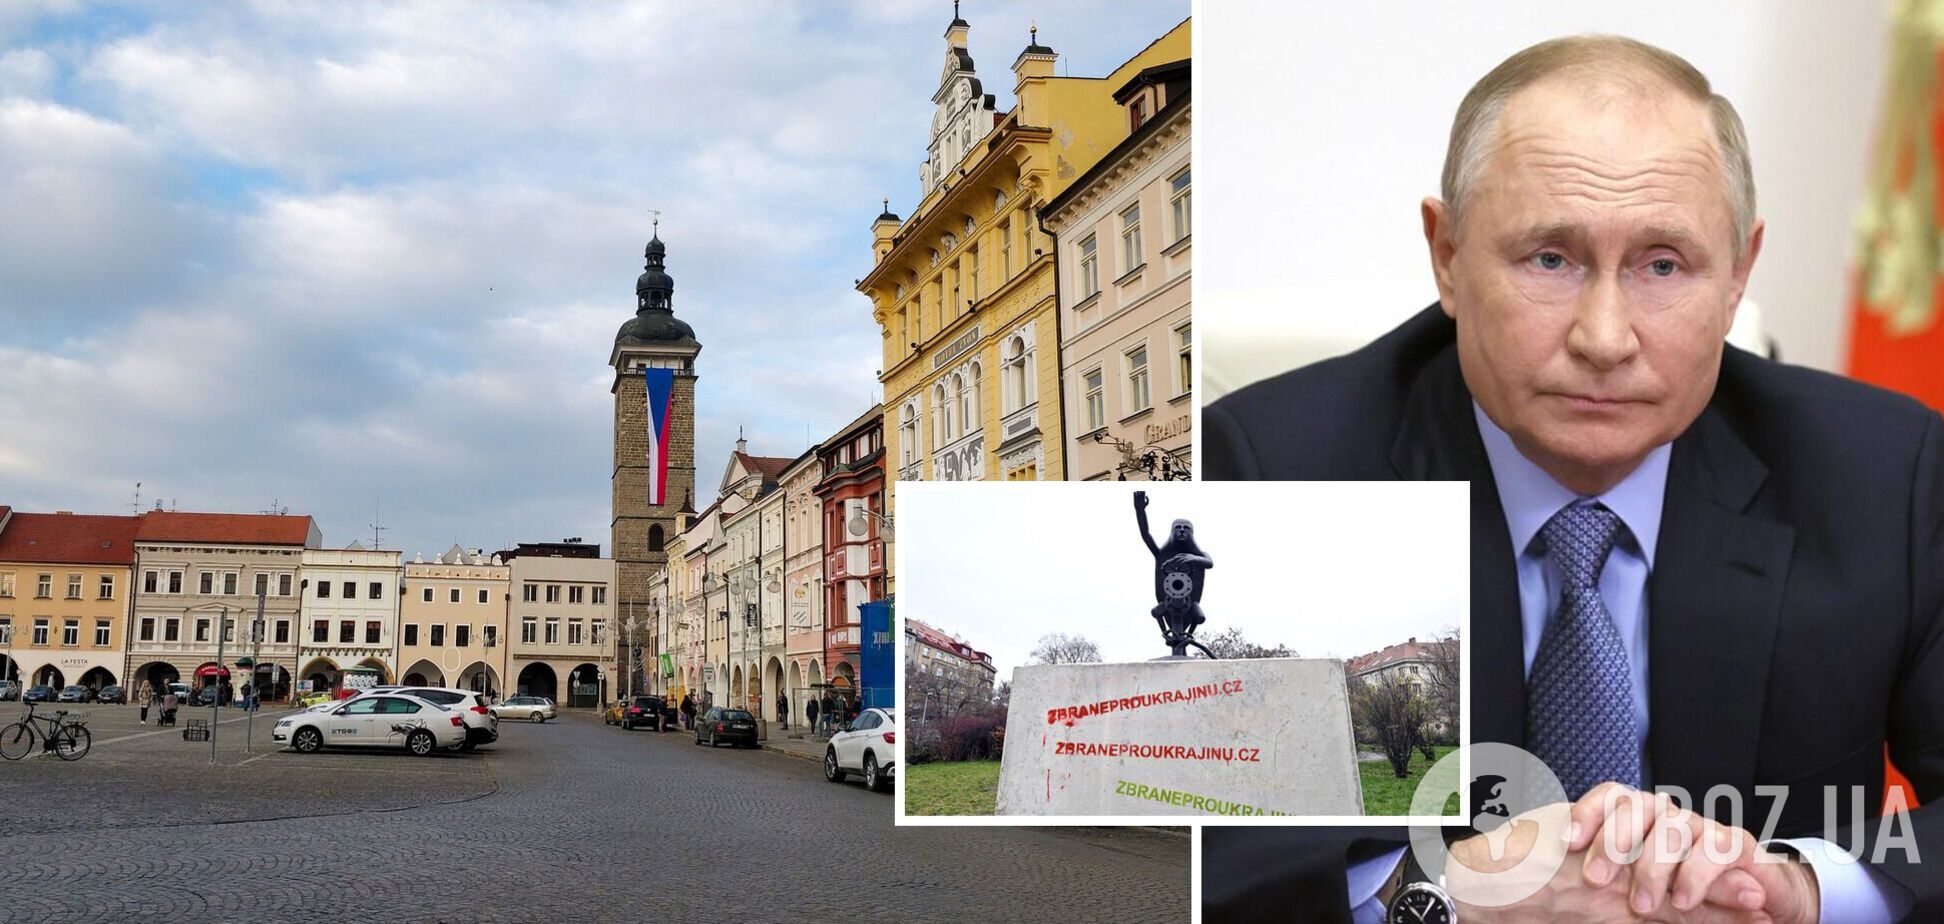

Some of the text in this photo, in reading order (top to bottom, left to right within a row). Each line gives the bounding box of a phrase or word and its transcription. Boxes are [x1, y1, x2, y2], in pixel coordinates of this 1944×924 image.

[1143, 414, 1192, 445] GRAND
[1047, 679, 1244, 725] ZBRANEPROUKRAJINU.CZ
[1055, 741, 1261, 763] ZBRANEPROUKRAJINU.CZ
